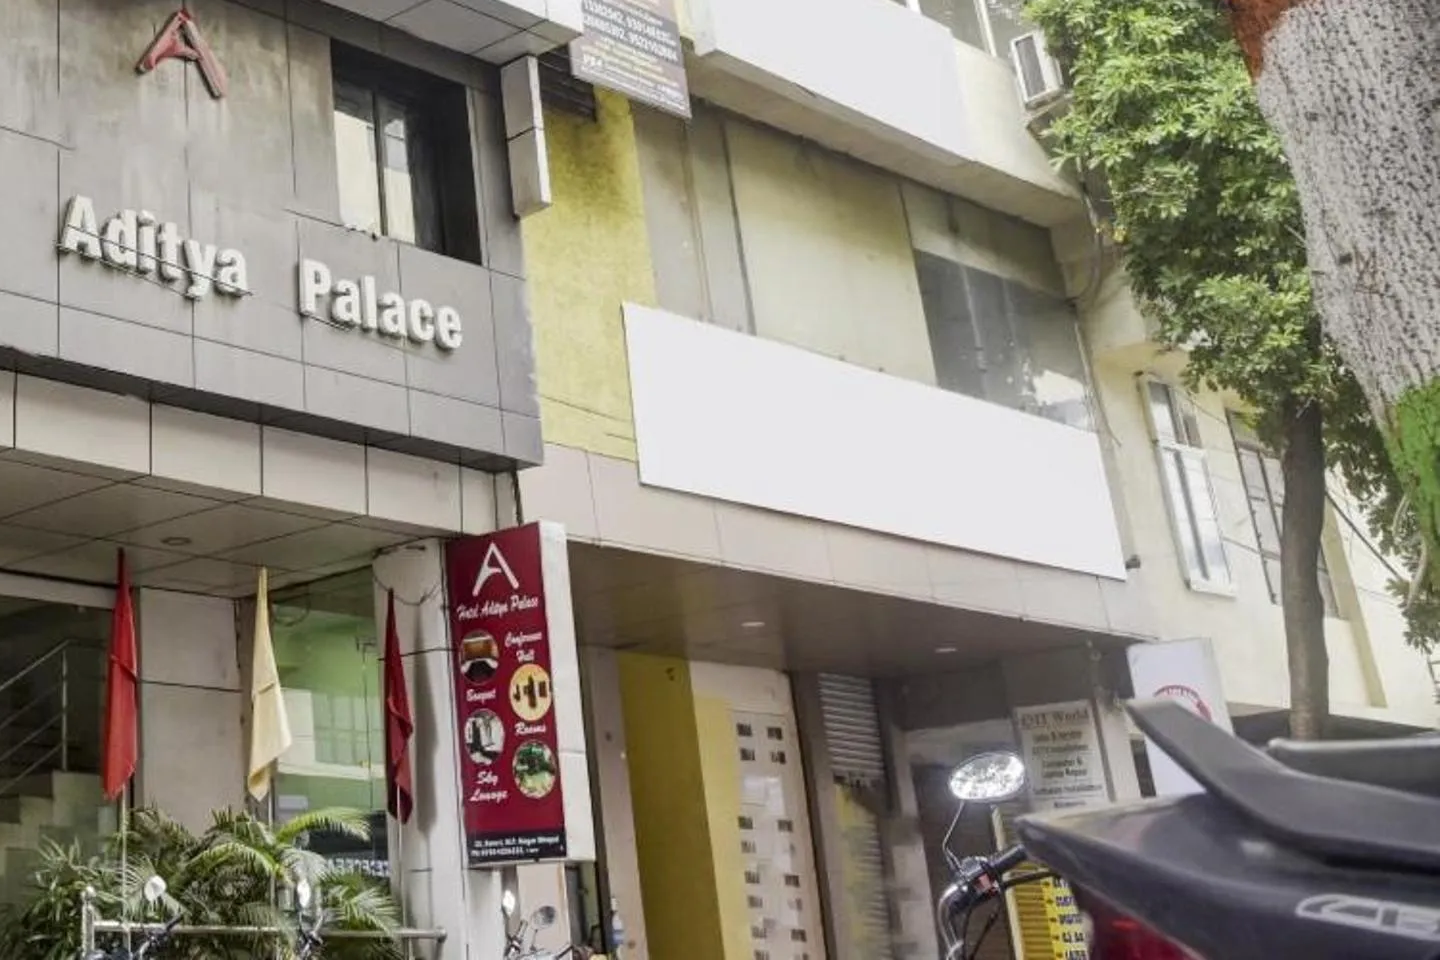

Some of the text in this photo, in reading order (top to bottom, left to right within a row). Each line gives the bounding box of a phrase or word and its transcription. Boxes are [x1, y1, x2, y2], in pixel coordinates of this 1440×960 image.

[59, 194, 463, 350] Aditya Palace
[472, 542, 520, 597] A
[511, 594, 539, 611] Palace
[477, 771, 499, 787] Sky
[469, 790, 509, 804] Lounge
